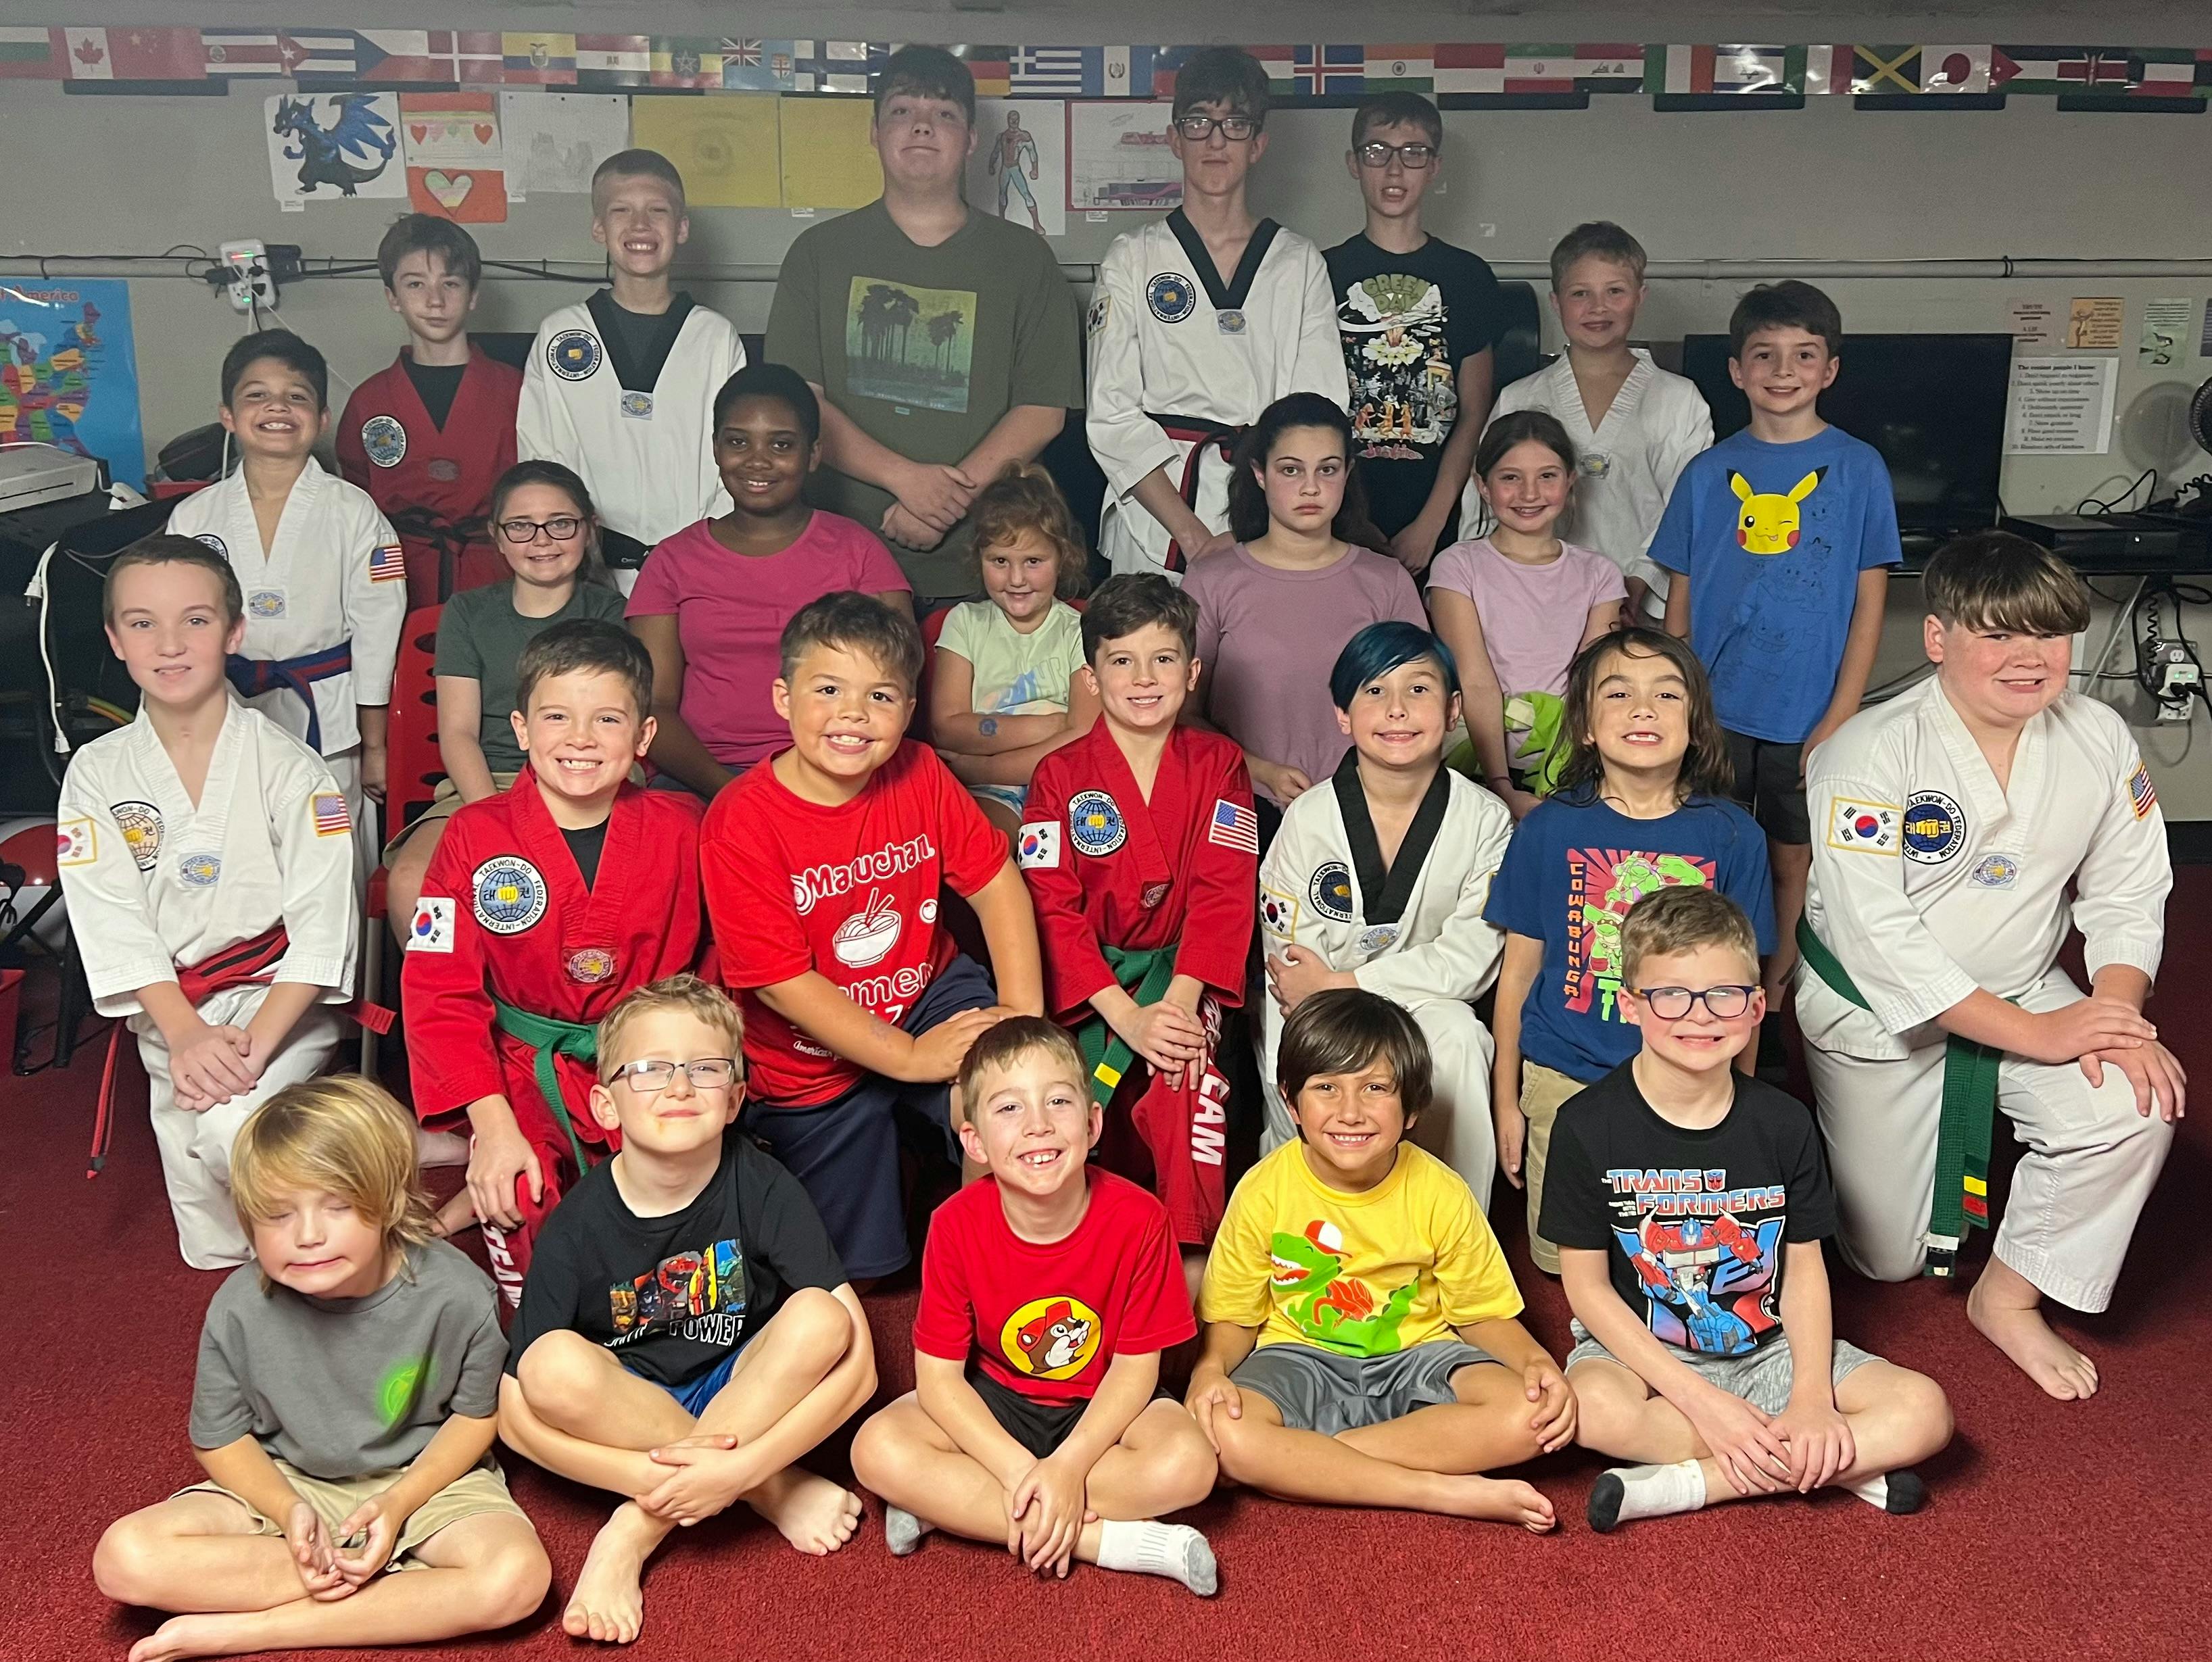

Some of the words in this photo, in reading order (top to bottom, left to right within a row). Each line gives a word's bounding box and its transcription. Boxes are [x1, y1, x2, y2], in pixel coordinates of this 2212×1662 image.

[1072, 792, 1115, 806] TAEKWON-DO
[1938, 816, 1962, 858] FEDERATION
[479, 859, 532, 877] TAEKWON-DO
[521, 880, 544, 926] FEDERATION
[483, 889, 496, 901] 태
[1564, 863, 1584, 998] COWABUNGA
[1191, 1056, 1230, 1166] EAM
[1606, 1169, 1702, 1194] TRANS
[1636, 1185, 1785, 1215] FORMERS
